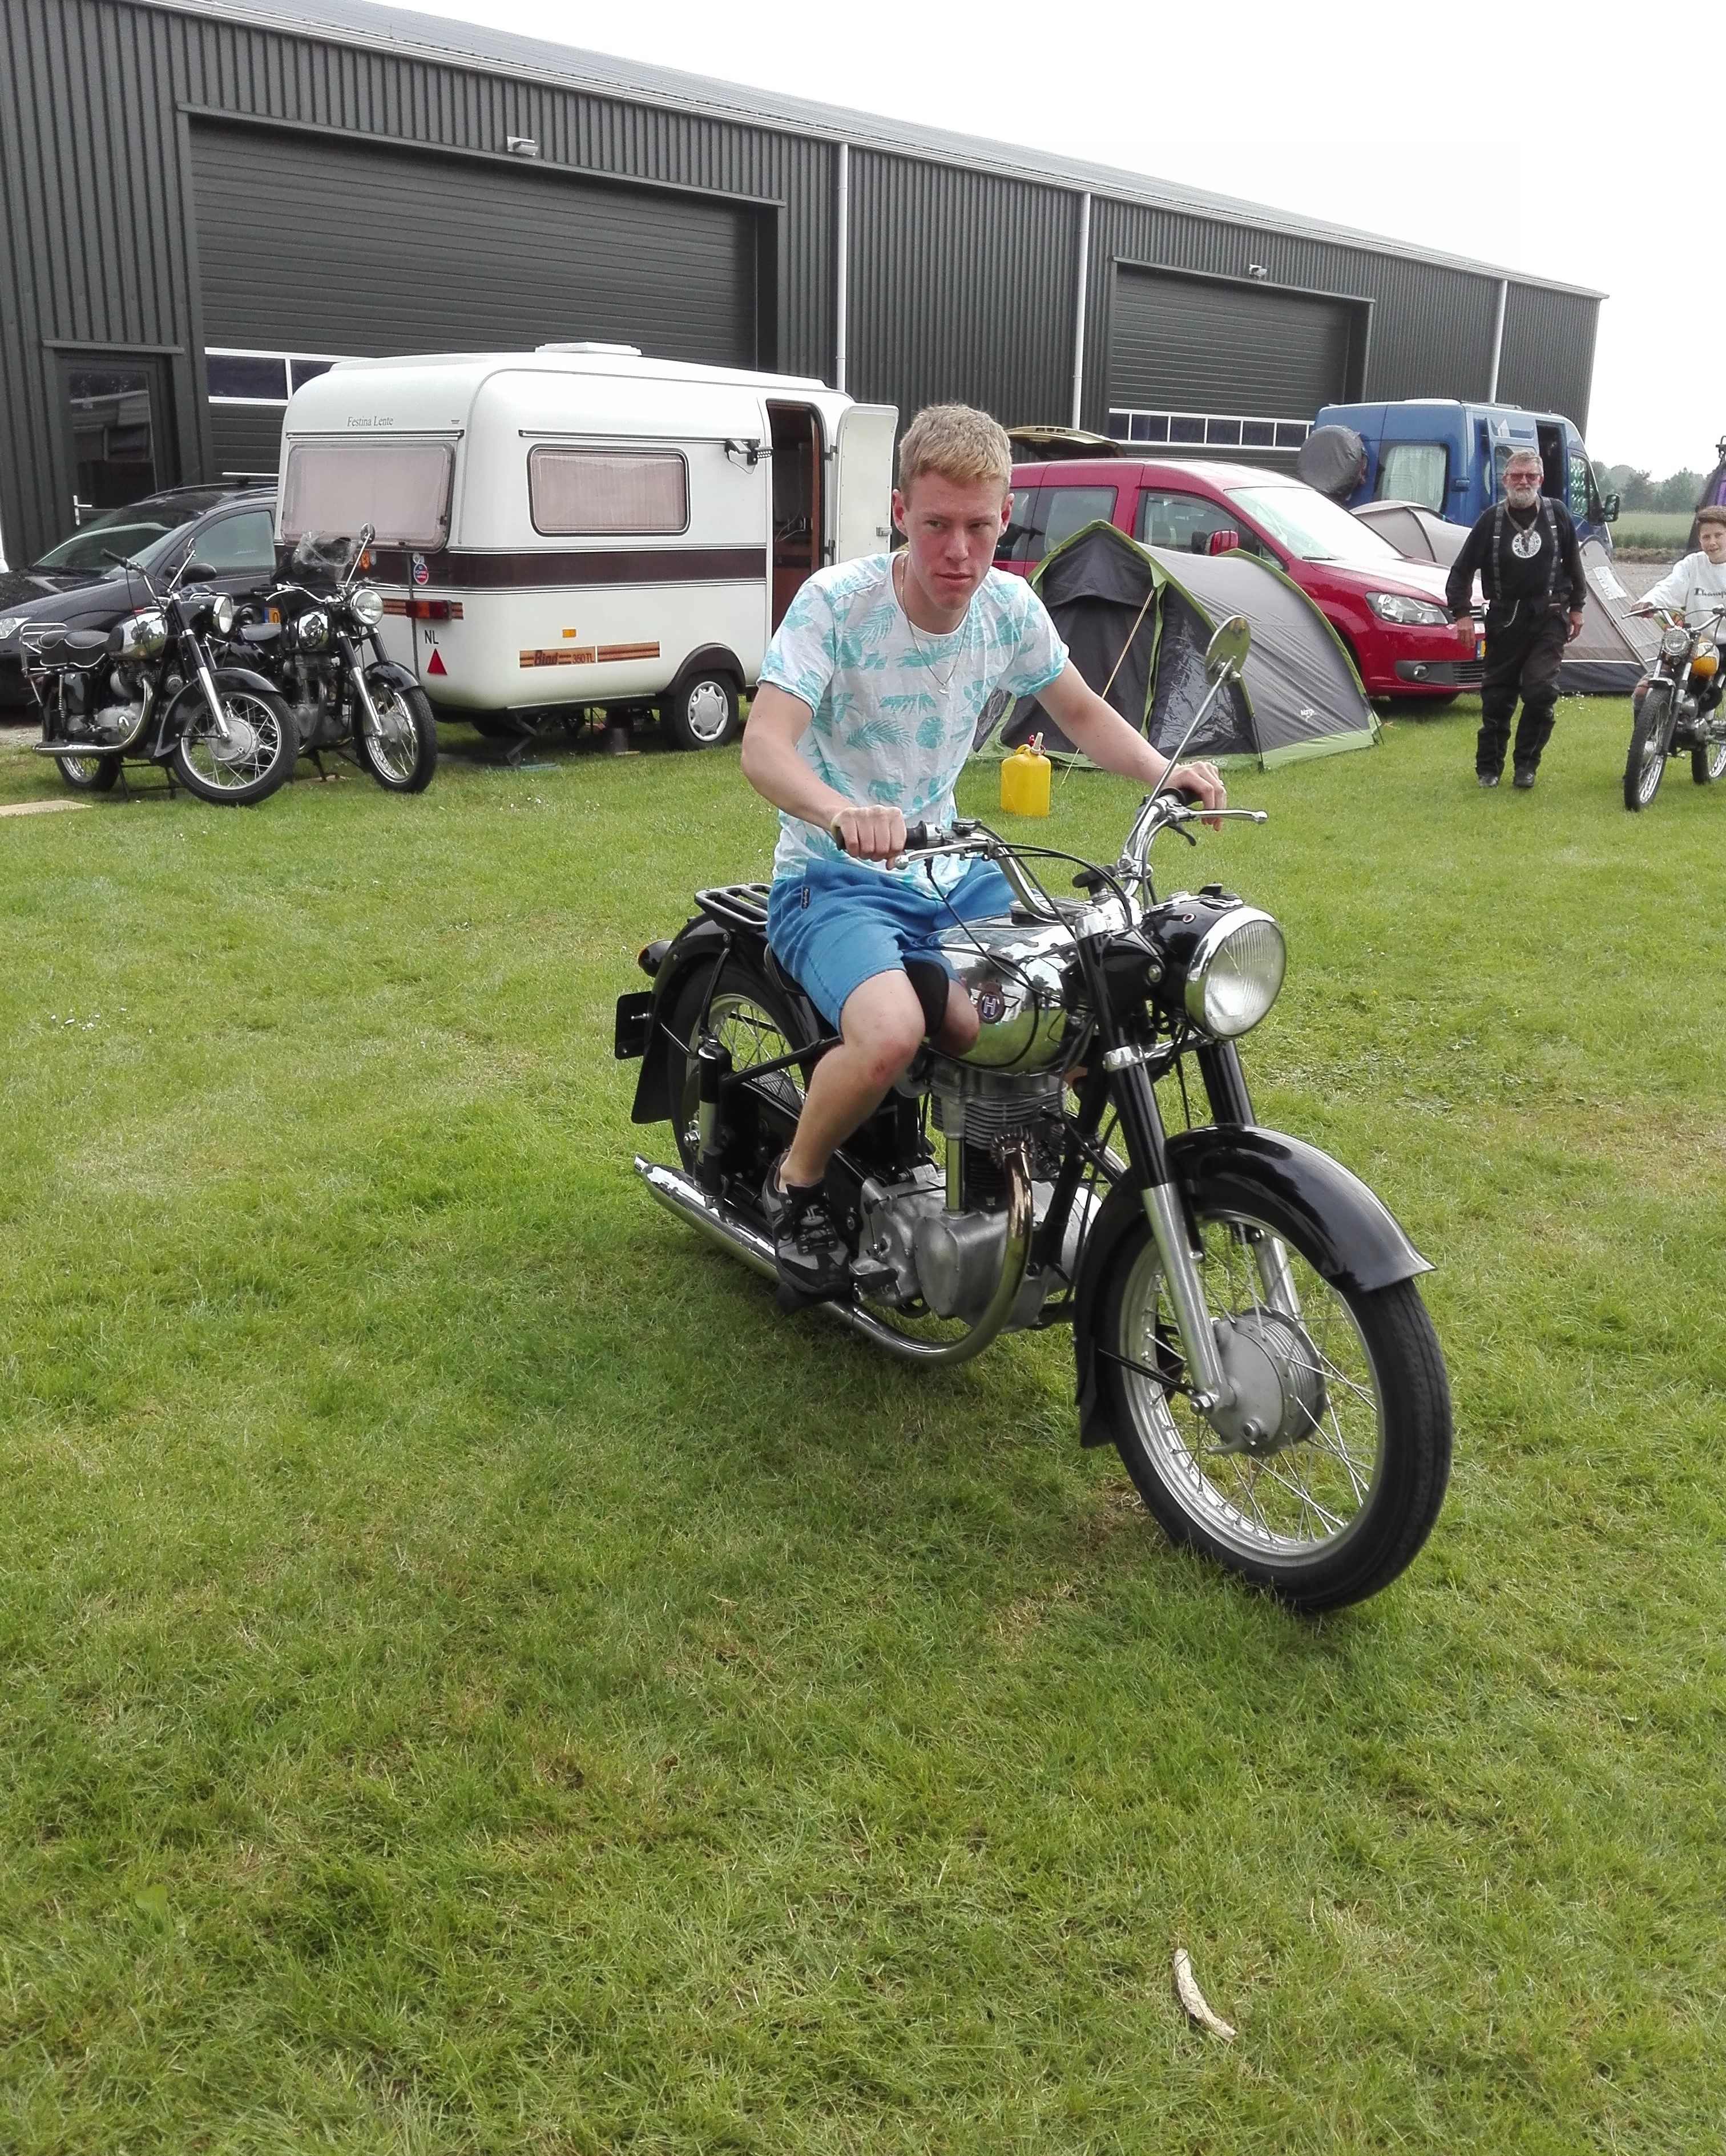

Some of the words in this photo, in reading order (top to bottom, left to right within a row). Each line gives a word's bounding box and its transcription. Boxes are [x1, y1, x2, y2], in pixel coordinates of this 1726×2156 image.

[347, 416, 372, 427] Festina
[374, 415, 393, 426] Lente
[425, 629, 439, 644] NL
[983, 996, 997, 1015] H
